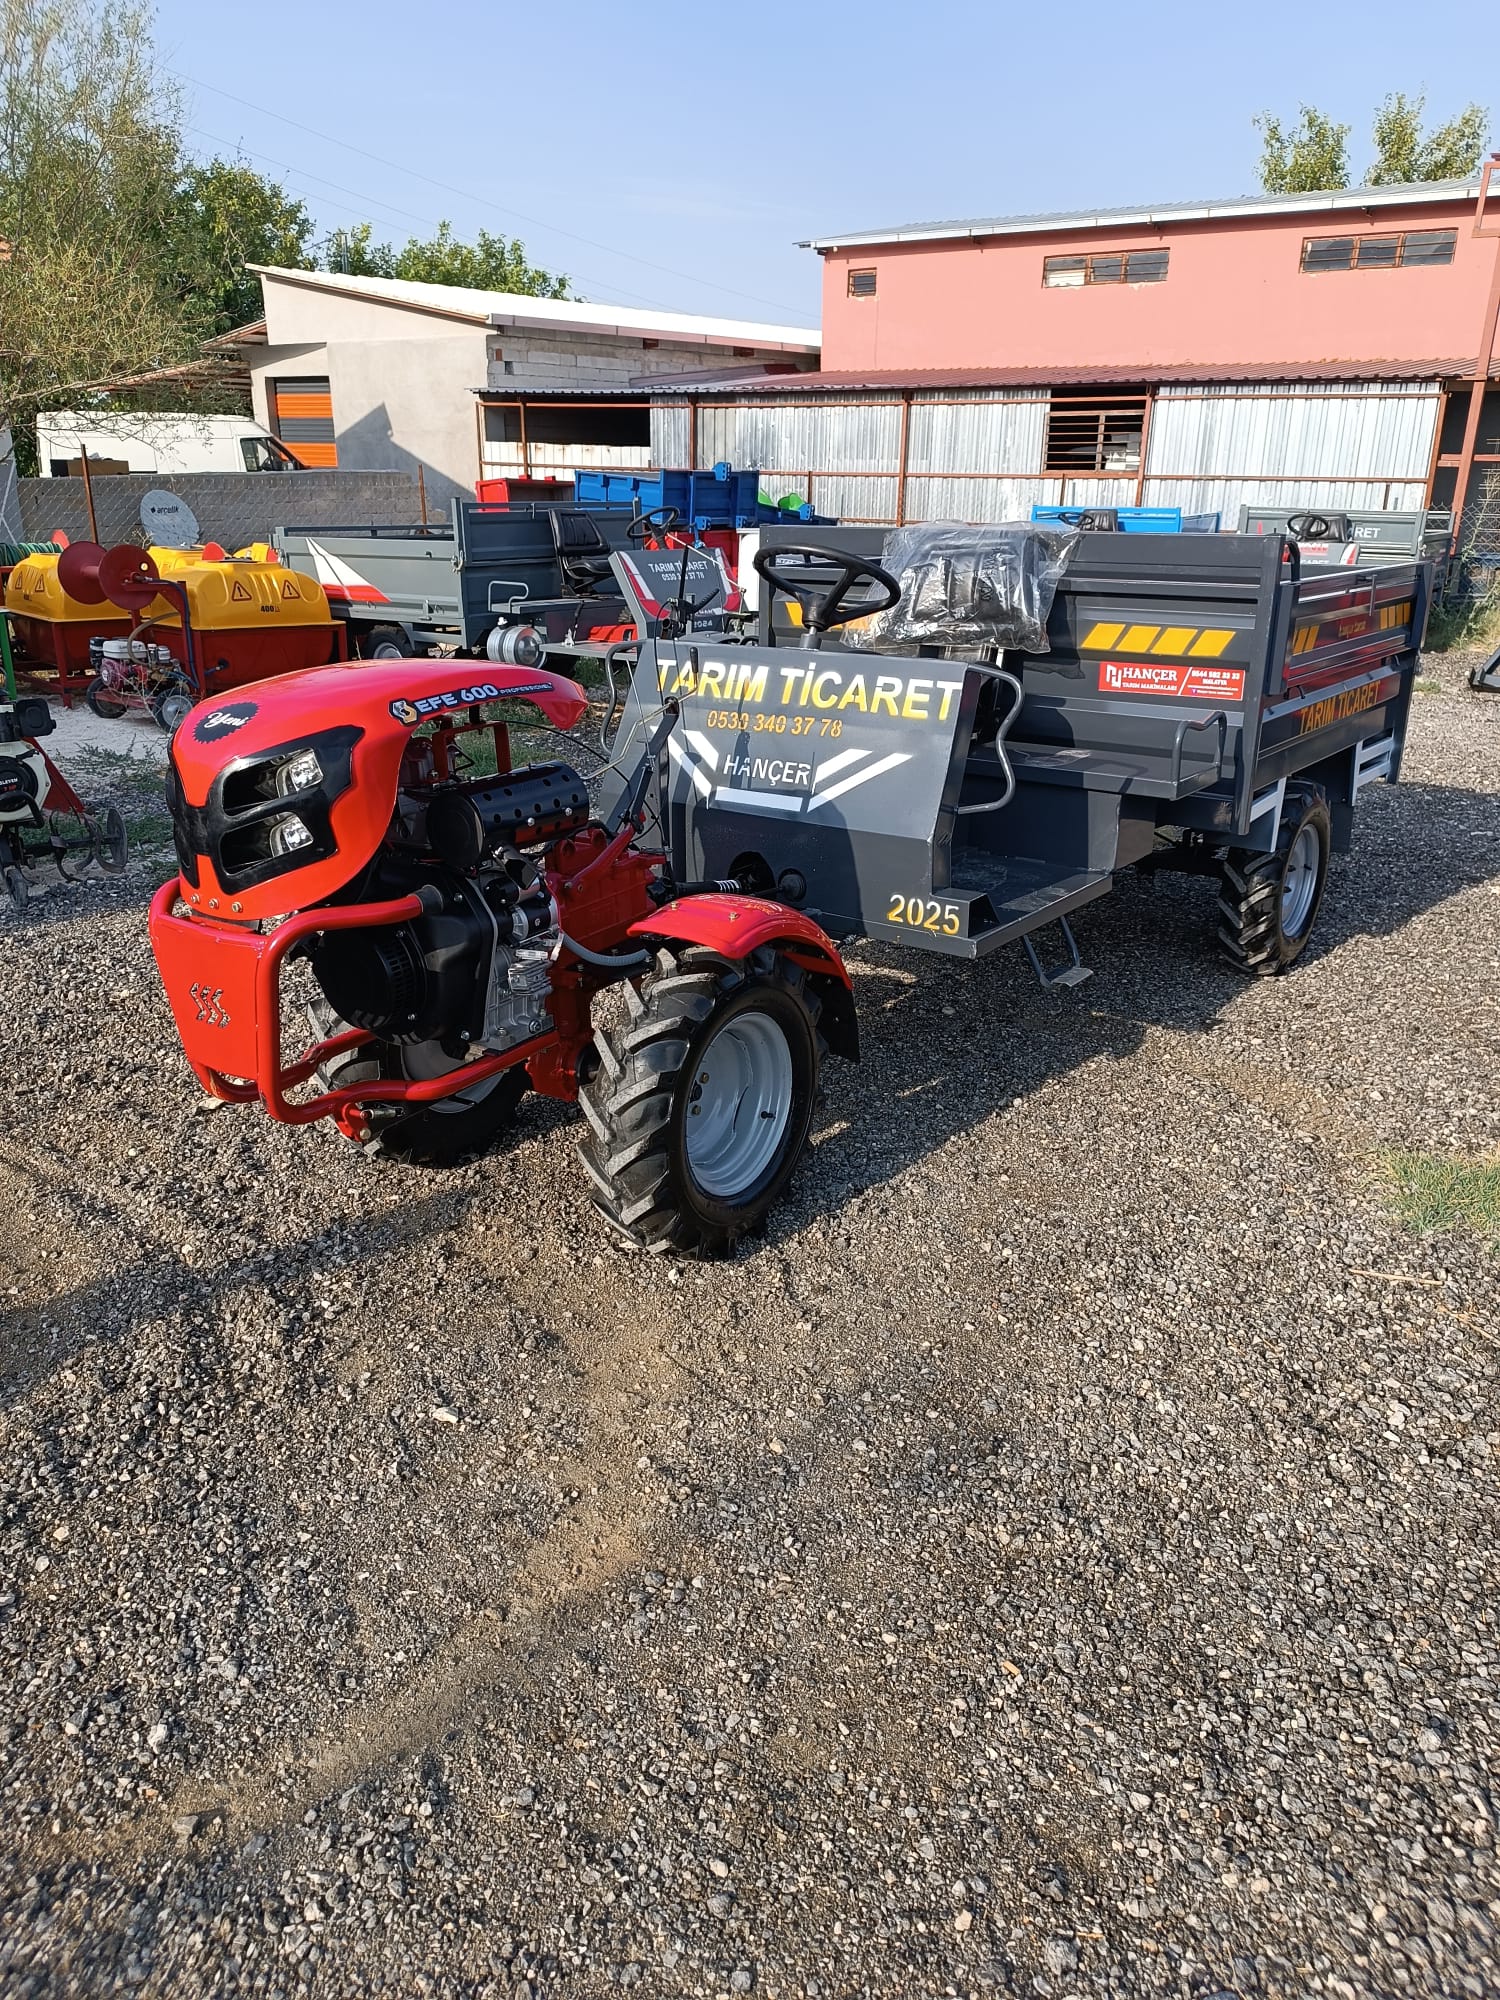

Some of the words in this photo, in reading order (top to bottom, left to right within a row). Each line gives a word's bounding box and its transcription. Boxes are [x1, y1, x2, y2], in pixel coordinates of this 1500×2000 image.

[648, 561, 675, 574] TARIM
[674, 560, 708, 571] TİARET
[260, 605, 275, 613] 400
[656, 659, 770, 703] TARIM
[779, 662, 964, 720] TİCARET
[1122, 667, 1178, 684] HANÇER
[415, 693, 458, 713] EFE
[460, 684, 499, 701] 600
[204, 712, 249, 729] Yeni
[707, 710, 749, 731] 0530
[753, 712, 786, 733] 340
[791, 716, 813, 736] 37
[820, 718, 843, 738] 78
[1300, 695, 1336, 735] TARIM
[723, 754, 811, 786] HANÇER
[887, 893, 960, 936] 2025
